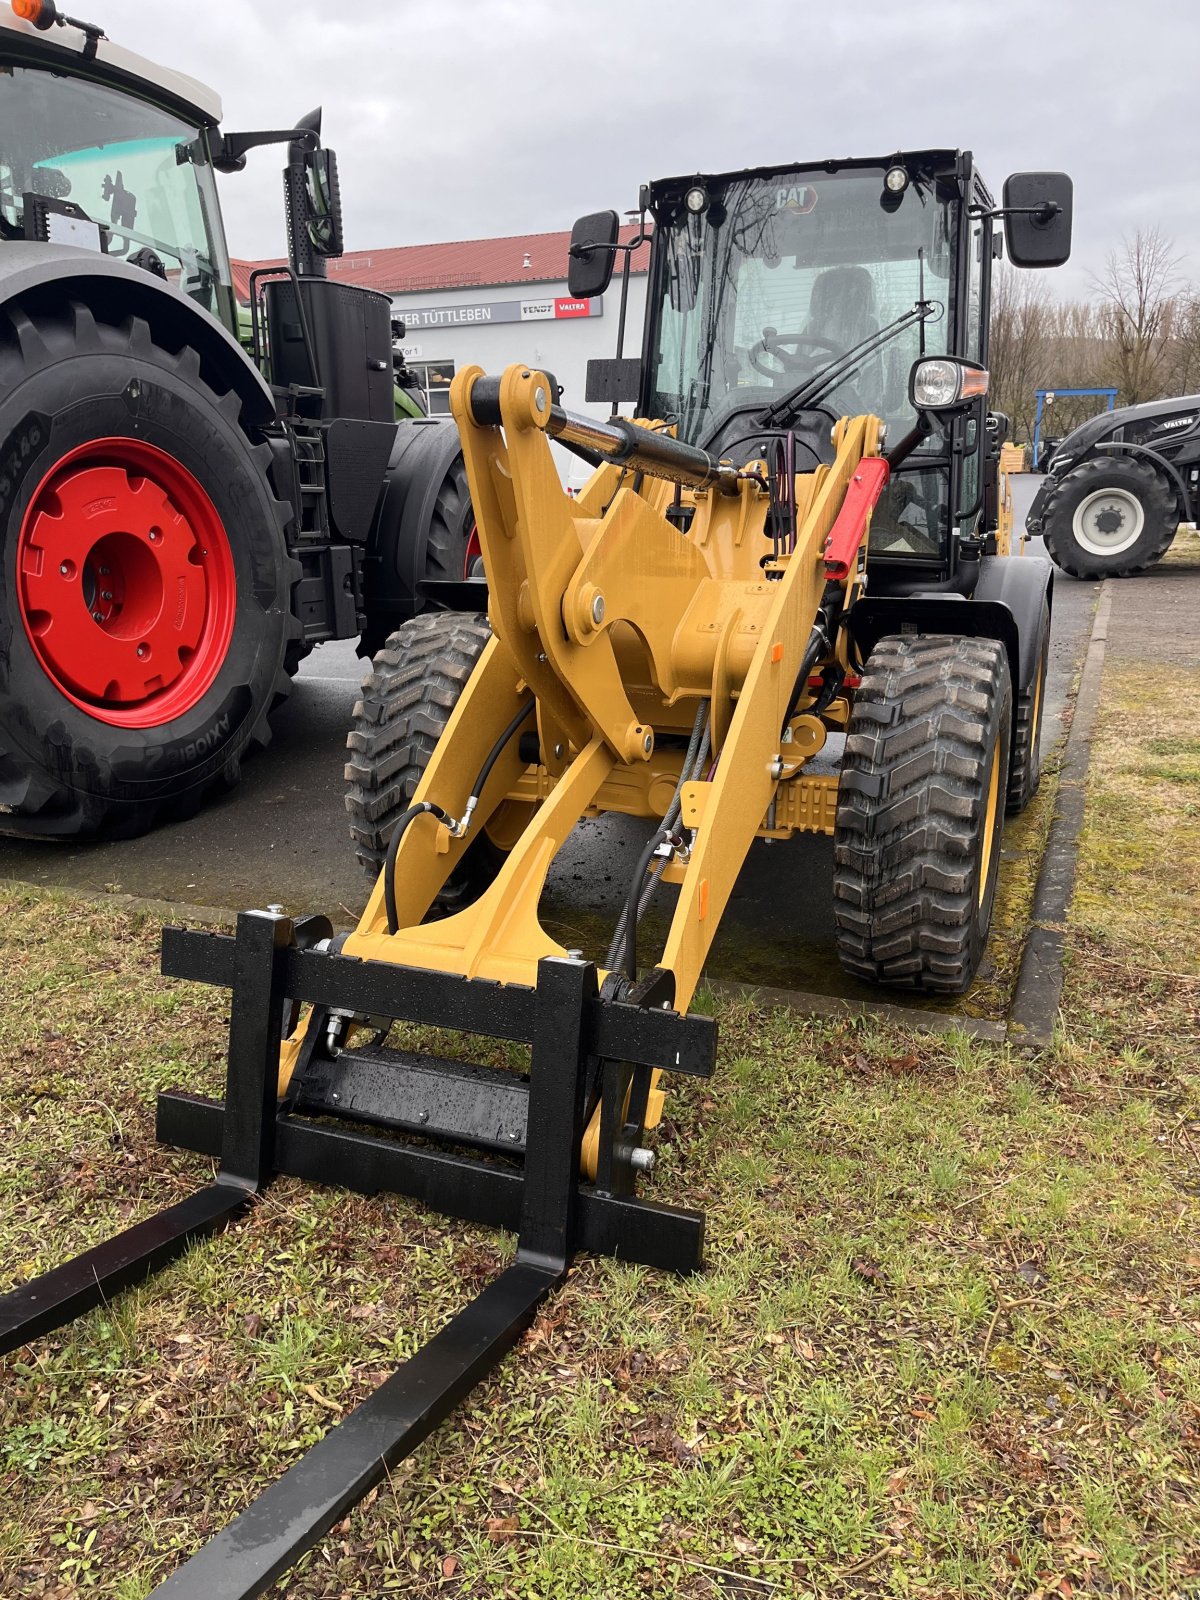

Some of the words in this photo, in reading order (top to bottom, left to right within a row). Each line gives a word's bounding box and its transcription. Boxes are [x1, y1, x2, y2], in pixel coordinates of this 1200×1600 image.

[777, 188, 807, 209] CAT
[421, 306, 491, 325] TÜTTLEBEN
[522, 304, 553, 315] FENDT
[559, 302, 586, 311] VALTRA
[1163, 417, 1193, 429] VALTRA
